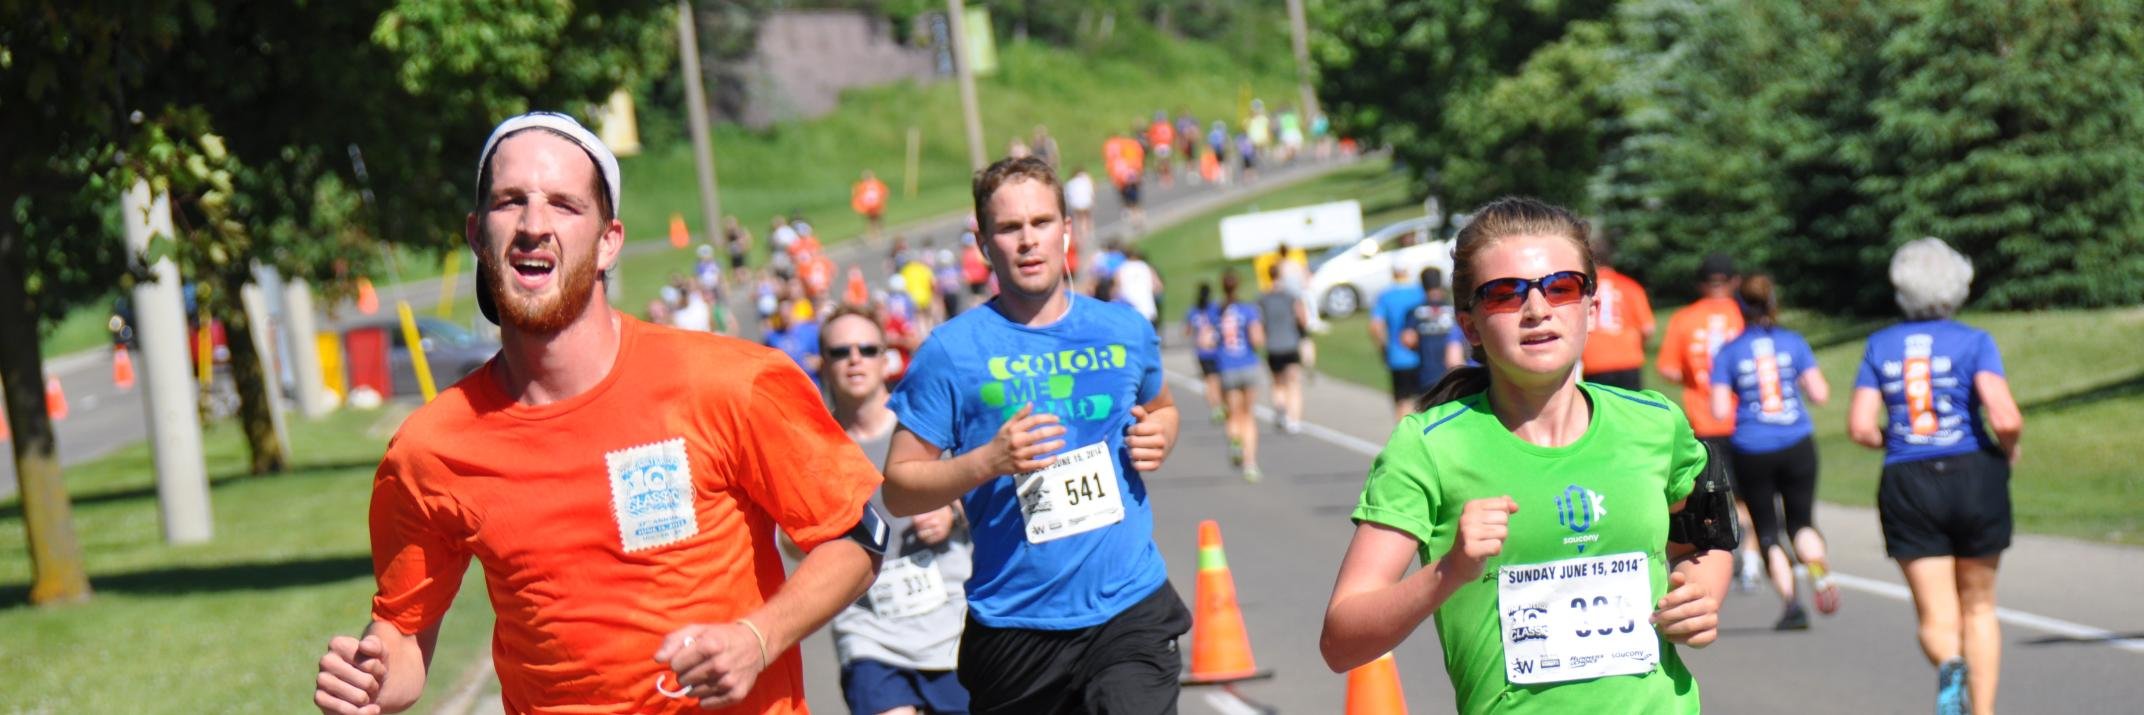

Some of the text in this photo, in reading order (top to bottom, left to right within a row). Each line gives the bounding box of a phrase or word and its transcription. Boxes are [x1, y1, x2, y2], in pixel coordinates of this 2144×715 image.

[1004, 346, 1113, 376] COLOR
[1003, 375, 1052, 403] ME
[1064, 471, 1106, 506] 541
[1554, 484, 1608, 533] 10K
[1563, 533, 1600, 545] saucony
[1508, 558, 1639, 584] SUNDAY JUNE 15, 2014
